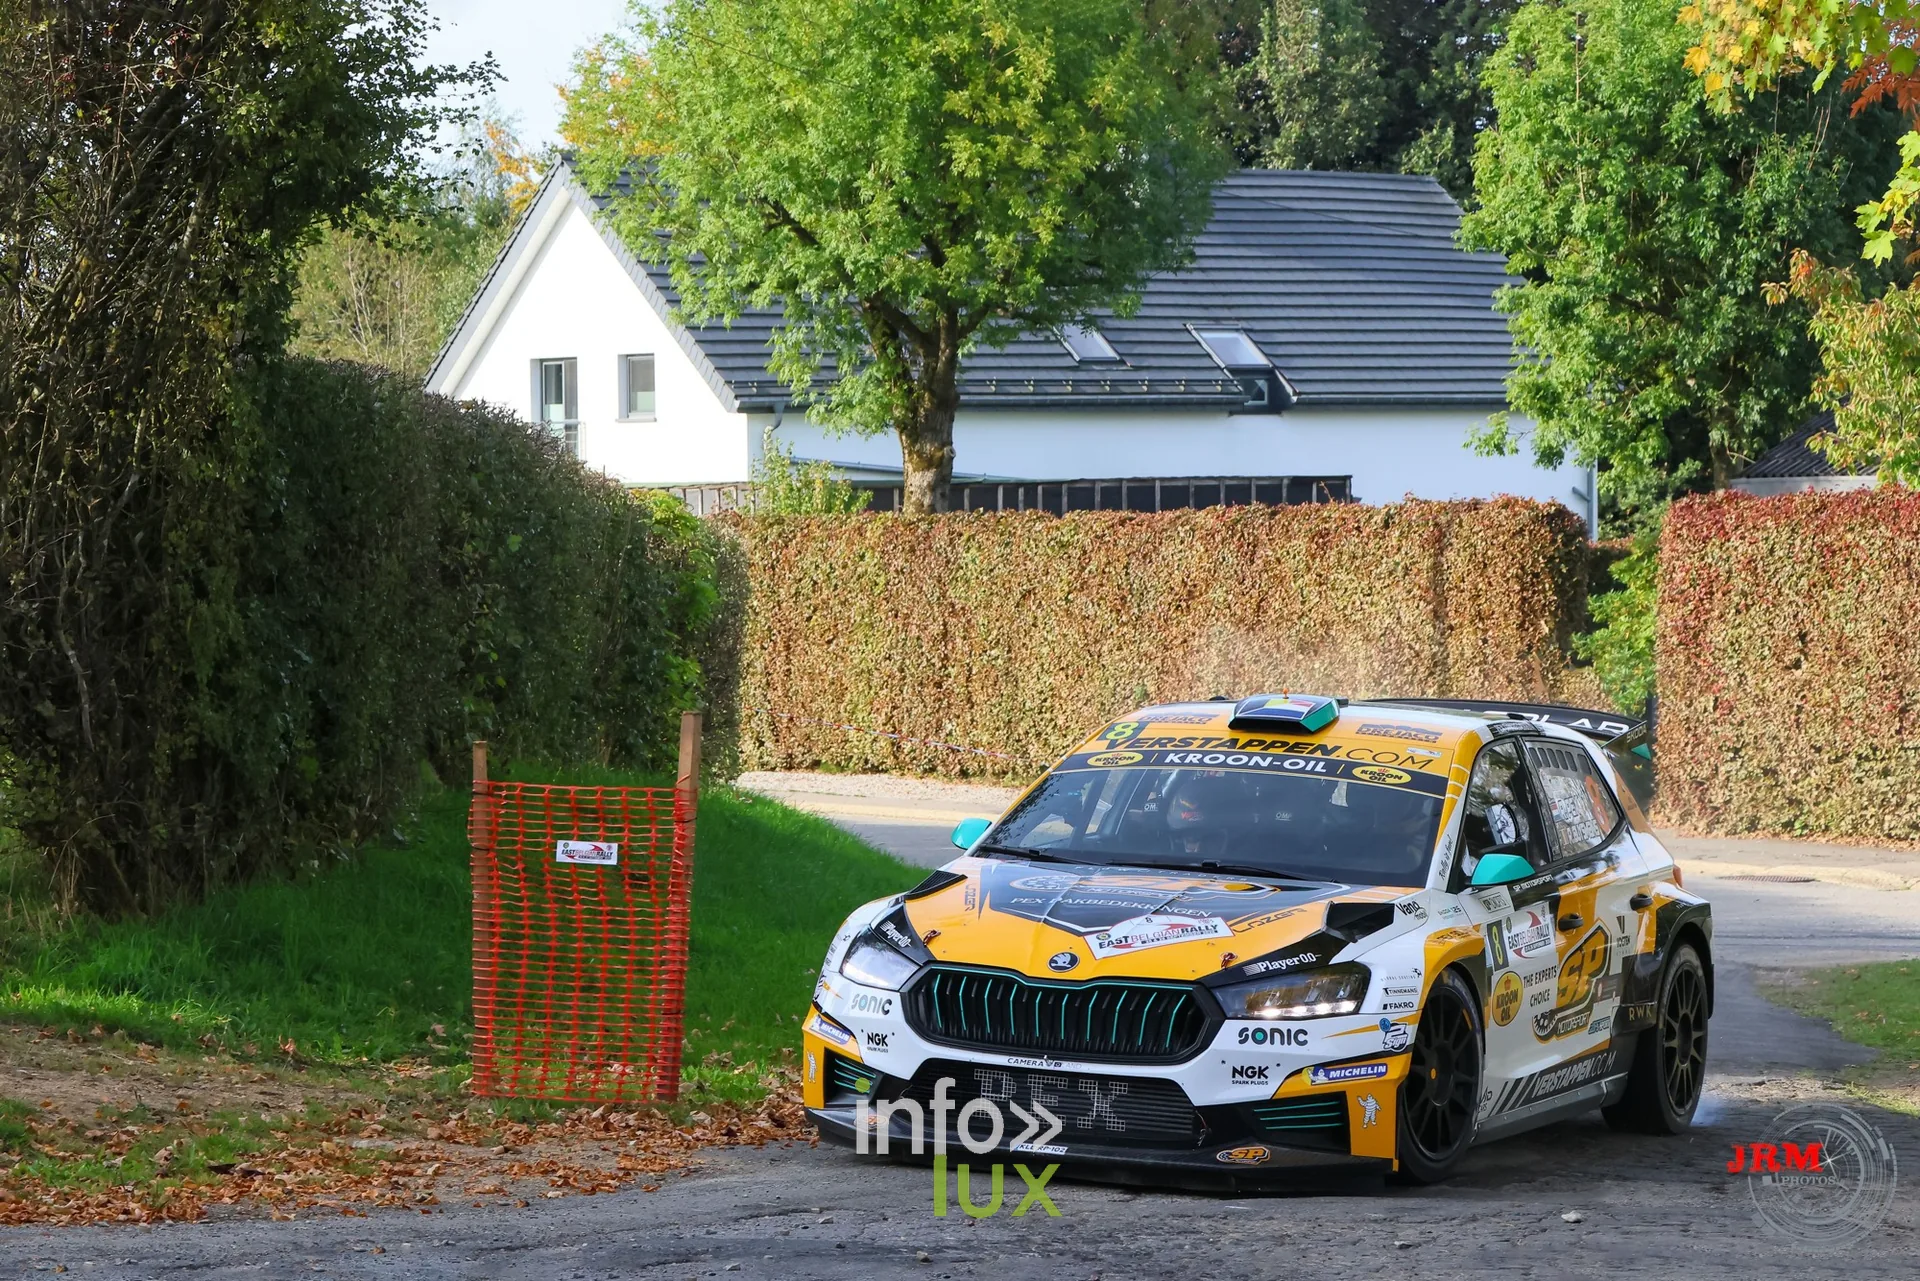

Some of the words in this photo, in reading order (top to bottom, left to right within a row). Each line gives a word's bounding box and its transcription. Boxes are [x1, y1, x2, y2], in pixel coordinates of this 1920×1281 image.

[1105, 721, 1140, 741] 8
[1357, 727, 1441, 742] DREJACO
[1095, 755, 1136, 763] KROON
[1104, 736, 1434, 769] VERSTAPPEN.COM
[1163, 752, 1327, 773] KROON-OIL
[1360, 769, 1403, 780] KROON
[1011, 897, 1047, 905] PEX
[1047, 897, 1213, 918] AKBEDEKKNGEN
[1395, 900, 1421, 916] Vano
[1492, 924, 1504, 966] 8
[1258, 956, 1300, 973] Player
[1556, 928, 1608, 1009] SP
[1523, 973, 1534, 989] THE
[1389, 1001, 1415, 1010] FAKRO
[1496, 988, 1519, 1010] KROON
[1530, 988, 1551, 1008] CHOICE
[1501, 1005, 1511, 1022] OIL
[821, 1023, 851, 1042] MICHELIN
[866, 1032, 889, 1047] NGK
[1007, 1057, 1044, 1067] CAMERA
[1231, 1065, 1270, 1080] NGK
[1329, 1065, 1387, 1079] MICHELIN
[1531, 1050, 1618, 1099] VERSTAPPEN.COM
[1229, 1148, 1265, 1160] SP
